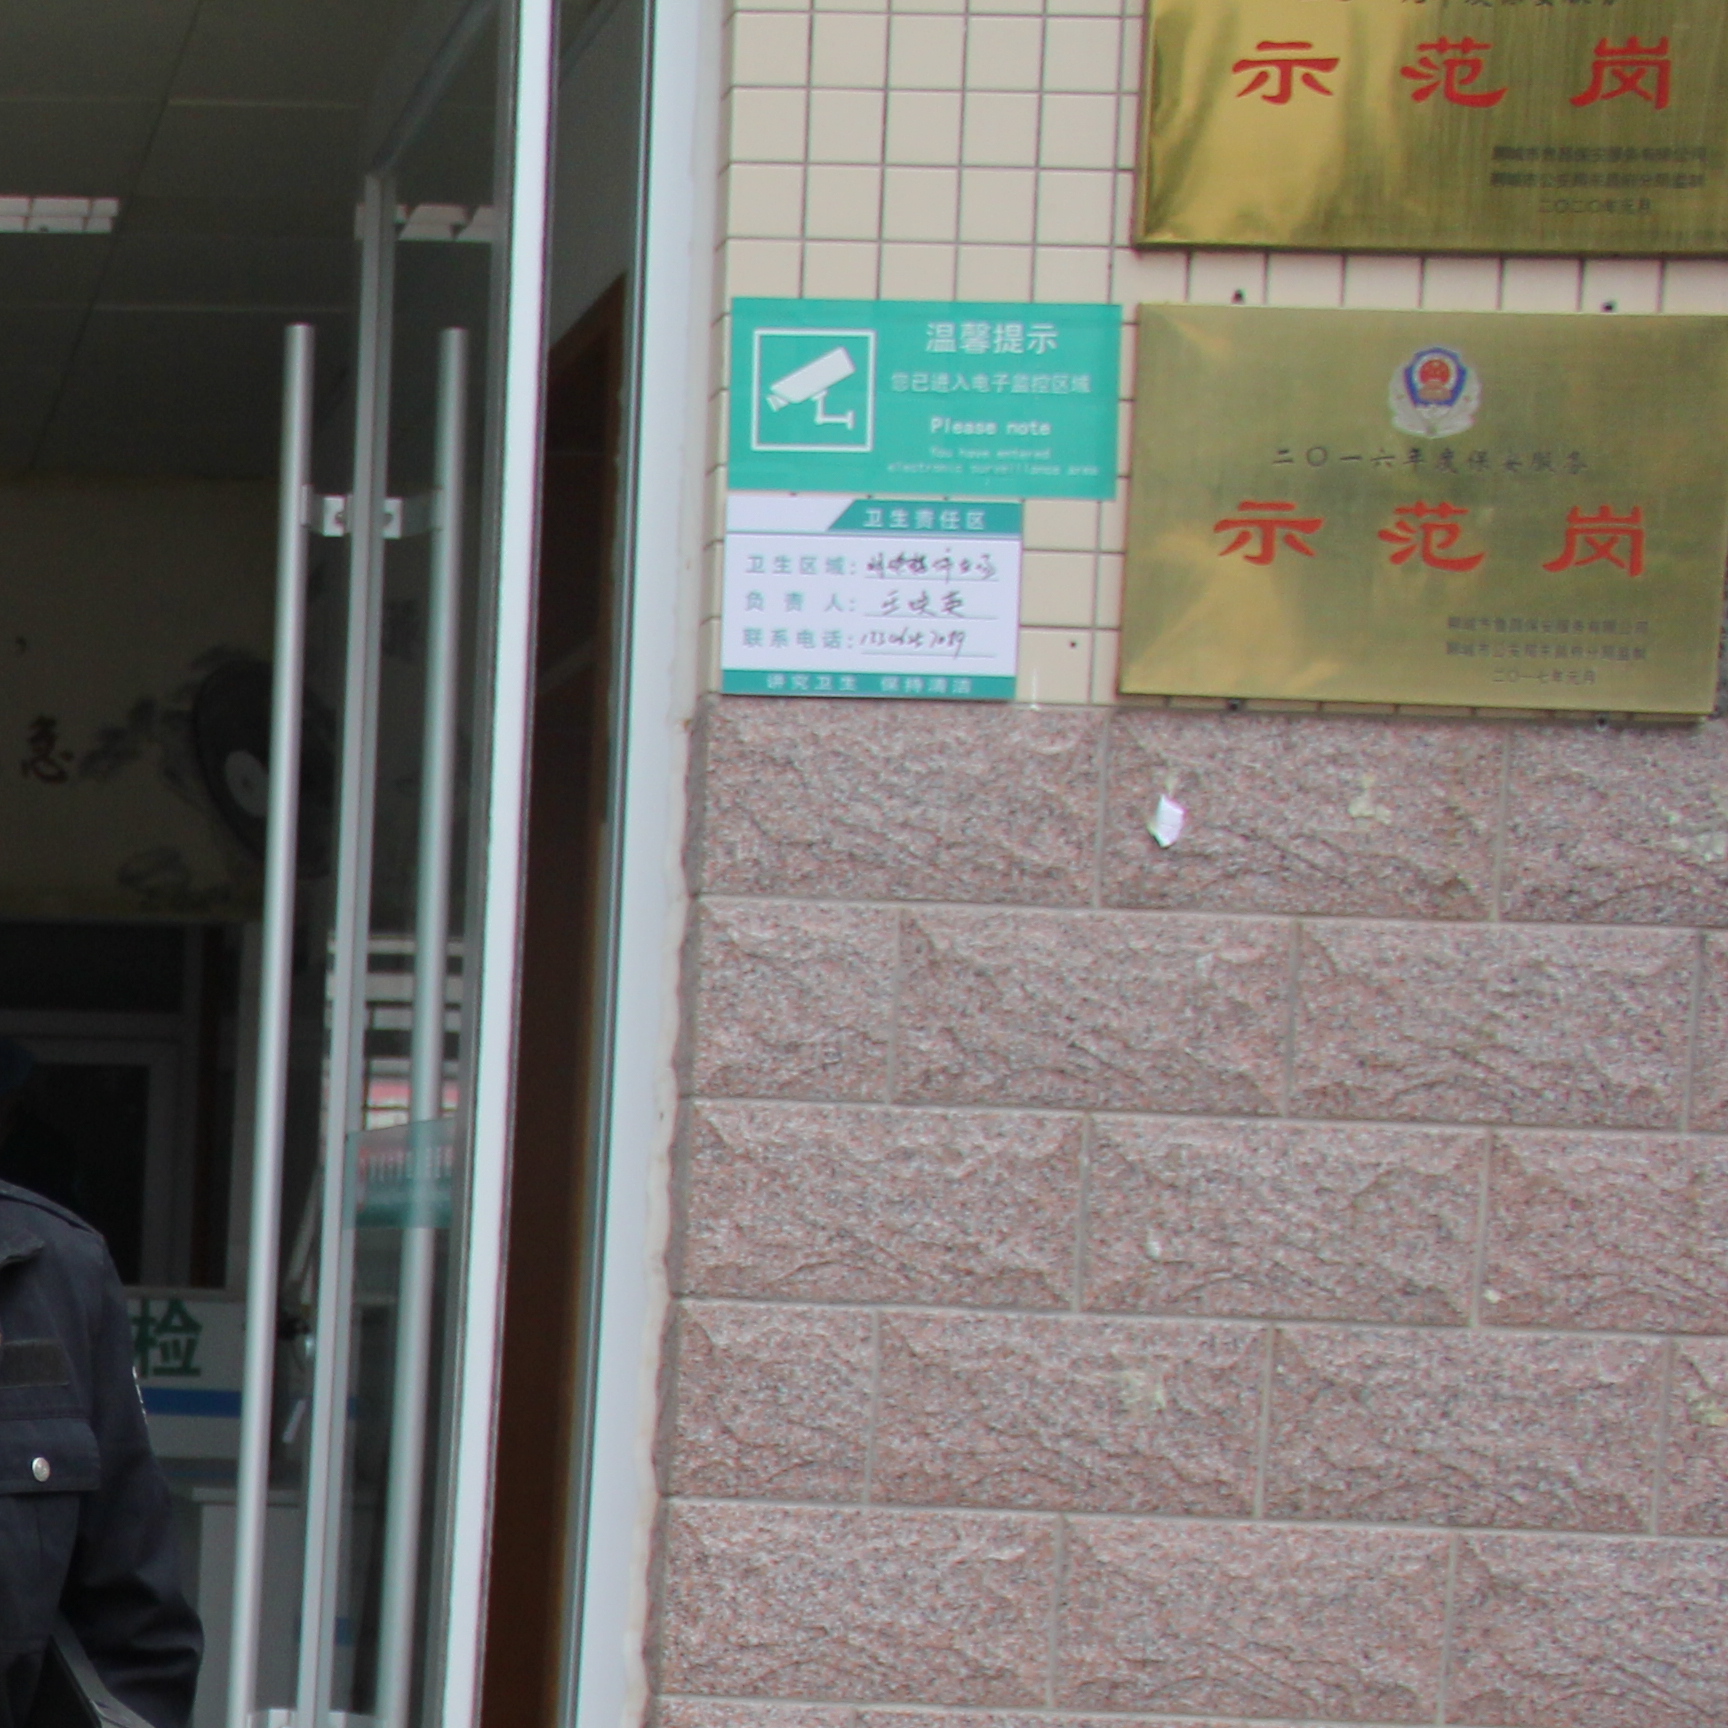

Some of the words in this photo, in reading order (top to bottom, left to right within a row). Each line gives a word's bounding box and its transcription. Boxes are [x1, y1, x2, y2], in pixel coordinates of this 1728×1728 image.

[1232, 35, 1672, 110] 示范岗
[925, 320, 1058, 354] 温馨提示
[891, 372, 1091, 394] 您已进入电子监控区域
[930, 416, 998, 435] Please
[1007, 420, 1052, 435] note
[863, 507, 987, 531] 卫生责任区
[1213, 500, 1644, 577] 示范岗
